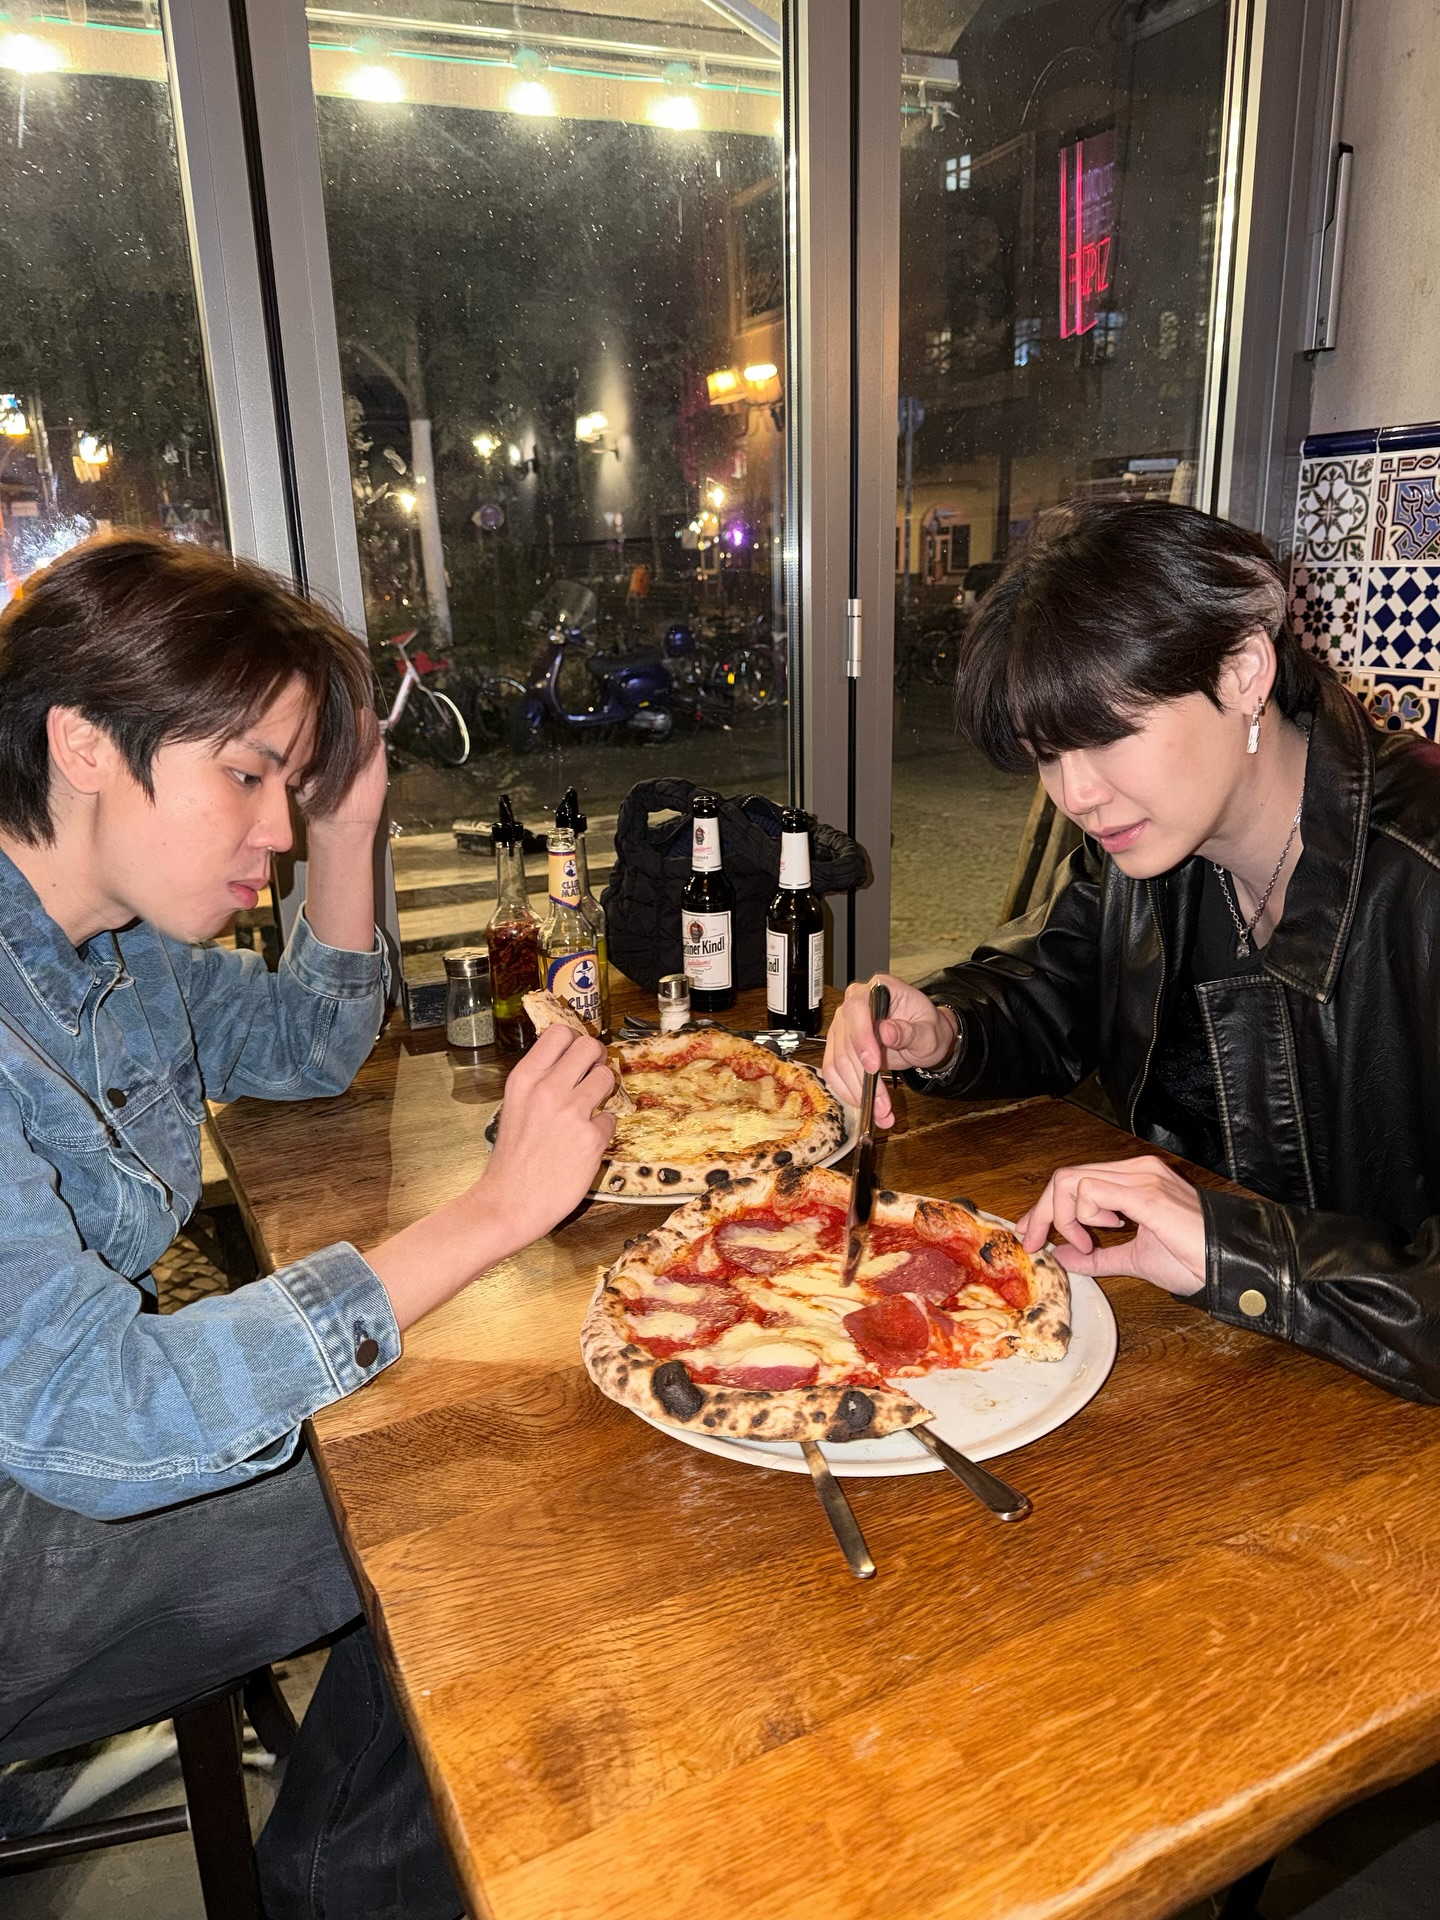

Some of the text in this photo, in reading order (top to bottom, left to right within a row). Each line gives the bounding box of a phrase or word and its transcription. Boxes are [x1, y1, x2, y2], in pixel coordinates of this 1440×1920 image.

[702, 936, 725, 955] Kindl
[767, 957, 780, 973] indl
[568, 991, 599, 1011] CLUB
